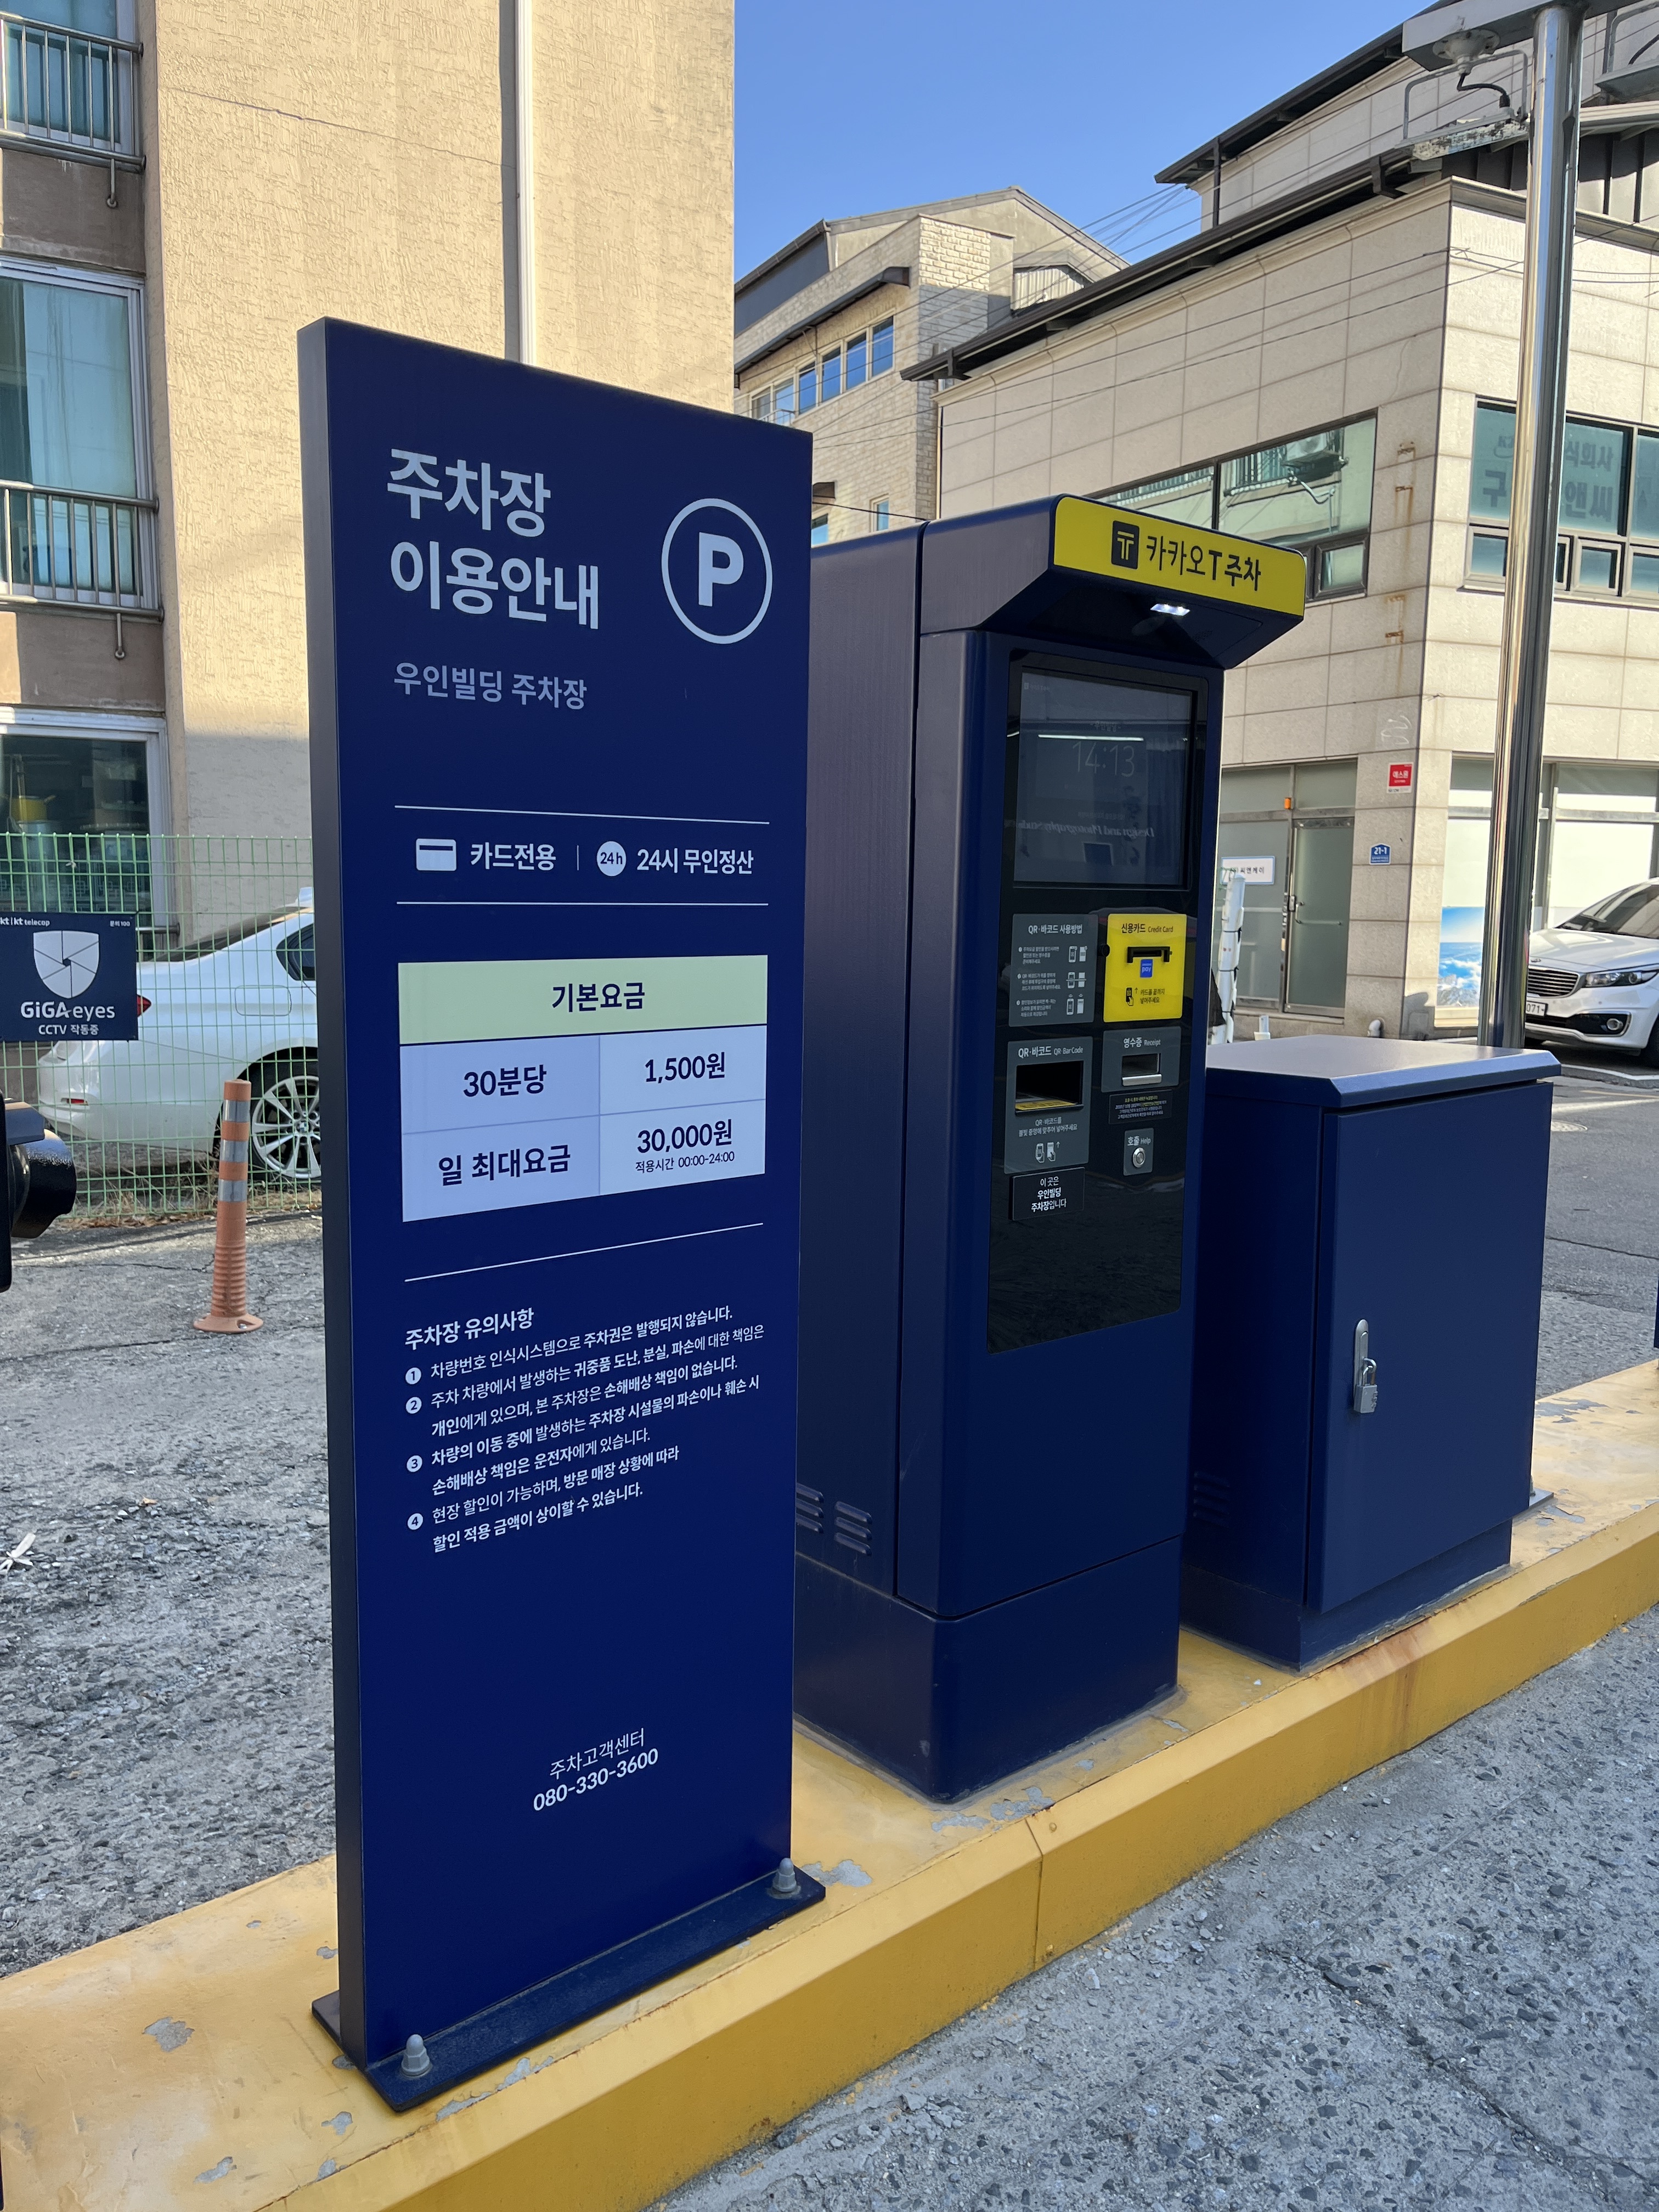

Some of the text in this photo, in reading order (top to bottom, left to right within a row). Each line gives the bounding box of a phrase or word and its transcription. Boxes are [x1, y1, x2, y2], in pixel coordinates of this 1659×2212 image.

[387, 448, 551, 538] 주차장
[390, 541, 599, 630] 이용안내
[698, 531, 744, 607] P
[394, 662, 587, 710] 우인빌딩 주차장
[1073, 741, 1135, 777] 14:13
[470, 842, 556, 871] 카드전용
[600, 851, 623, 866] 24h
[637, 848, 754, 875] 24시 무인정산
[1059, 924, 1083, 934] 사용방법
[1121, 923, 1146, 934] 신용카드
[551, 982, 646, 1013] 기본요금
[38, 1025, 67, 1035] CCTV
[1123, 1037, 1142, 1048] 영수증
[462, 1064, 547, 1097] 30분당
[645, 1052, 726, 1084] 1,500원
[637, 1119, 733, 1154] 30,000원
[1127, 1136, 1151, 1146] 호출 Help
[438, 1144, 571, 1186] 일 최대요금
[635, 1151, 735, 1175] 적용시간 00:00-24:00
[1031, 1198, 1067, 1212] 주차장입니다
[1037, 1187, 1062, 1200] 우인빌딩
[405, 1307, 534, 1351] 주차장 유의사항
[431, 1355, 487, 1379] 차량번호
[489, 1335, 581, 1368] 인식시스템으로
[584, 1325, 633, 1348] 주차권은
[636, 1314, 682, 1339] 발행되지
[685, 1305, 733, 1328] 않습니다.
[431, 1388, 460, 1408] 주차
[462, 1376, 516, 1401] 차량에서
[520, 1366, 571, 1390] 발생하는
[573, 1356, 611, 1378] 귀중품
[613, 1350, 641, 1369] 도난,
[643, 1344, 669, 1363] 분실,
[671, 1336, 706, 1356] 파손에
[708, 1331, 730, 1348] 대한
[732, 1324, 764, 1343] 책임은
[431, 1355, 738, 1437] 개인에게 있으며, 본 주차장은 손해배상 책임이 없습니다.
[431, 1442, 473, 1466] 차량의
[476, 1435, 504, 1454] 이동
[506, 1428, 533, 1449] 중에
[535, 1418, 585, 1442] 발생하는
[588, 1406, 626, 1429] 주차장
[628, 1394, 675, 1418] 시설물의
[676, 1384, 723, 1407] 파손이나
[724, 1379, 747, 1395] 훼손
[748, 1374, 760, 1390] 시
[432, 1427, 651, 1496] 손해배상 책임은 운전자에게 있습니다.
[432, 1503, 461, 1525] 현장
[463, 1491, 503, 1516] 할인이
[506, 1477, 561, 1503] 가능하며,
[563, 1469, 589, 1489] 방문
[591, 1462, 616, 1481] 매장
[618, 1452, 653, 1475] 상황에
[656, 1445, 680, 1464] 따라
[433, 1481, 644, 1553] 할인 적용 금액이 상이할 수 있습니다.
[550, 1728, 644, 1780] 주차고객센터
[533, 1748, 658, 1811] 080-330-3600
